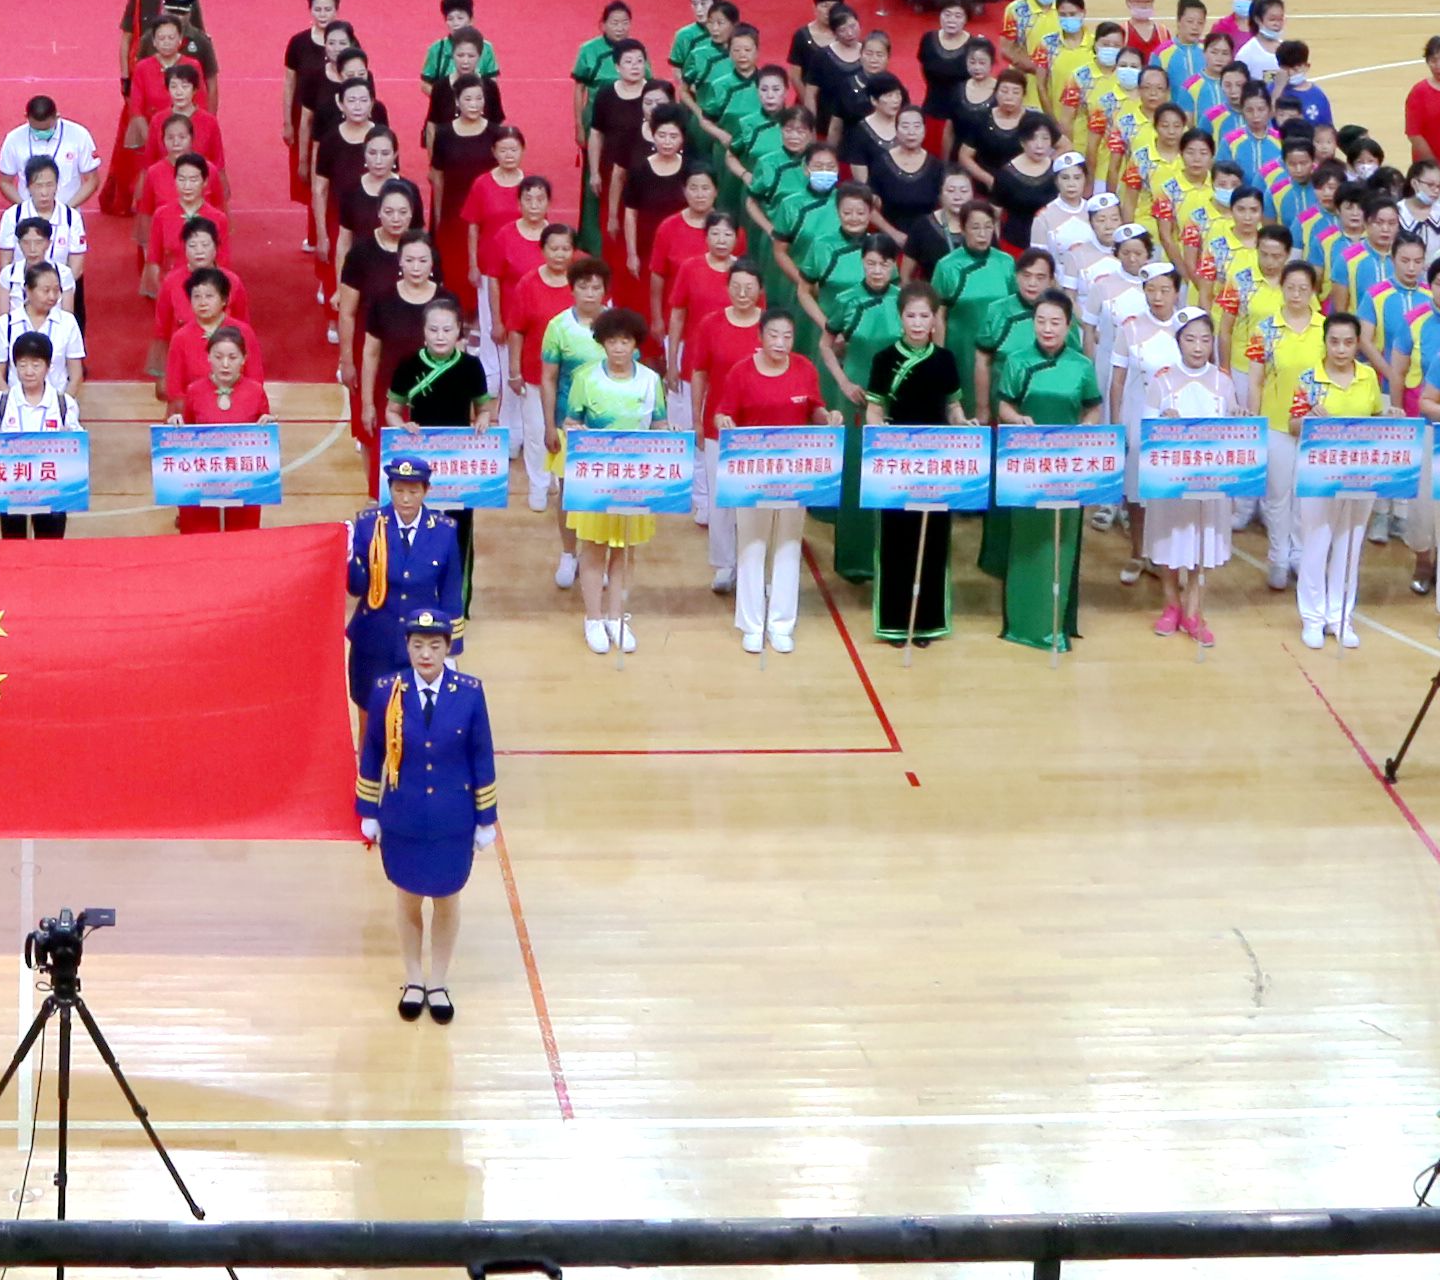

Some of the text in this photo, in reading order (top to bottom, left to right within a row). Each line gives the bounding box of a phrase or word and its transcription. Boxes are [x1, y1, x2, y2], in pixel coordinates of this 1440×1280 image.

[163, 456, 269, 473] 开心快乐舞蹈队
[576, 461, 682, 479] 济宁阳光梦之队
[1007, 456, 1115, 474] 时尚模特艺术团
